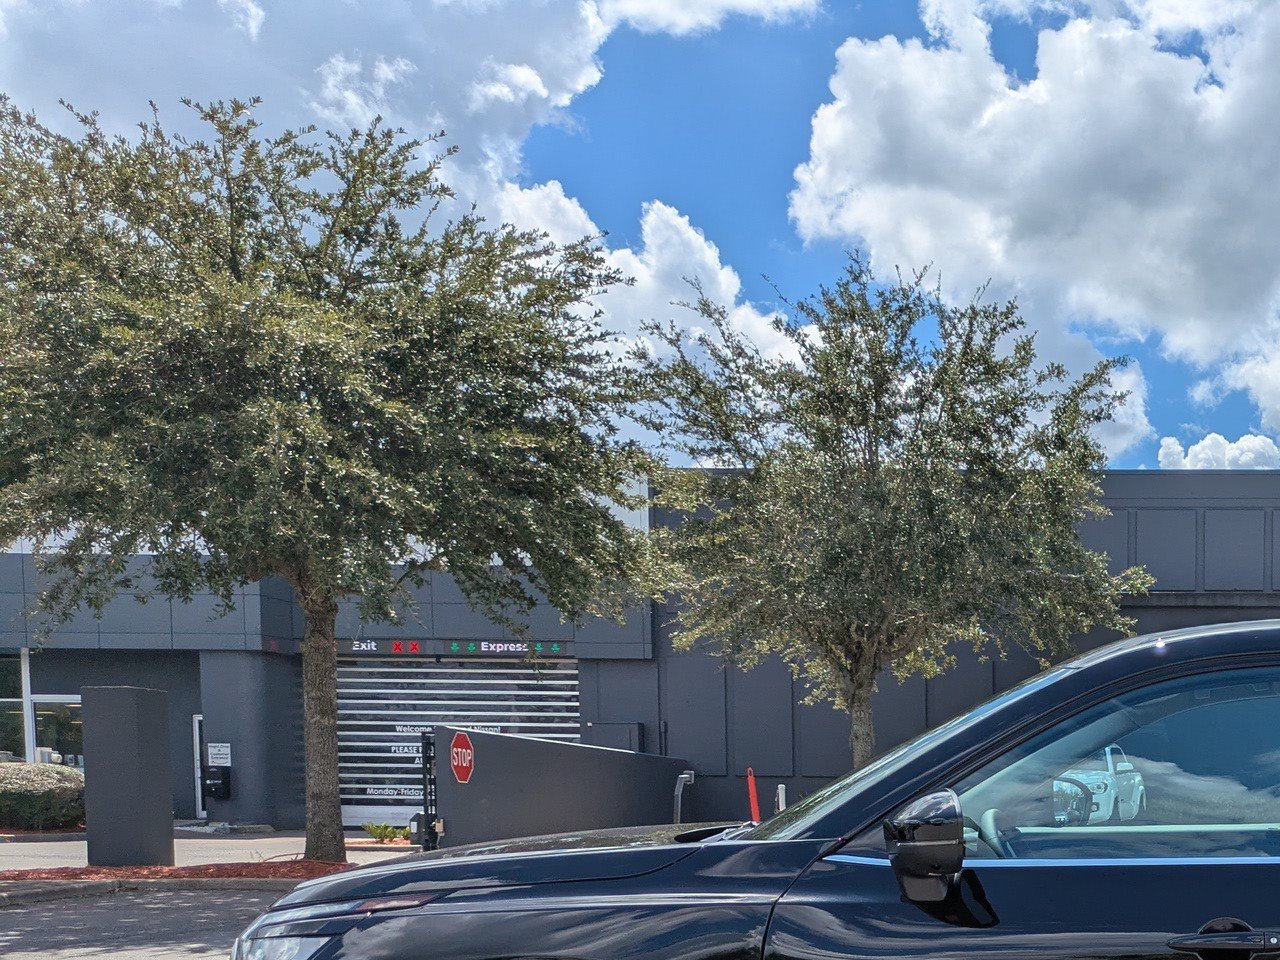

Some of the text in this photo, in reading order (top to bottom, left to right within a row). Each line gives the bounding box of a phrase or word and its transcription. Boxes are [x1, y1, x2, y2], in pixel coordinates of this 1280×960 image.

[352, 640, 528, 652] Exit Express
[452, 747, 472, 767] STOP
[366, 787, 424, 796] Monday-Friday
